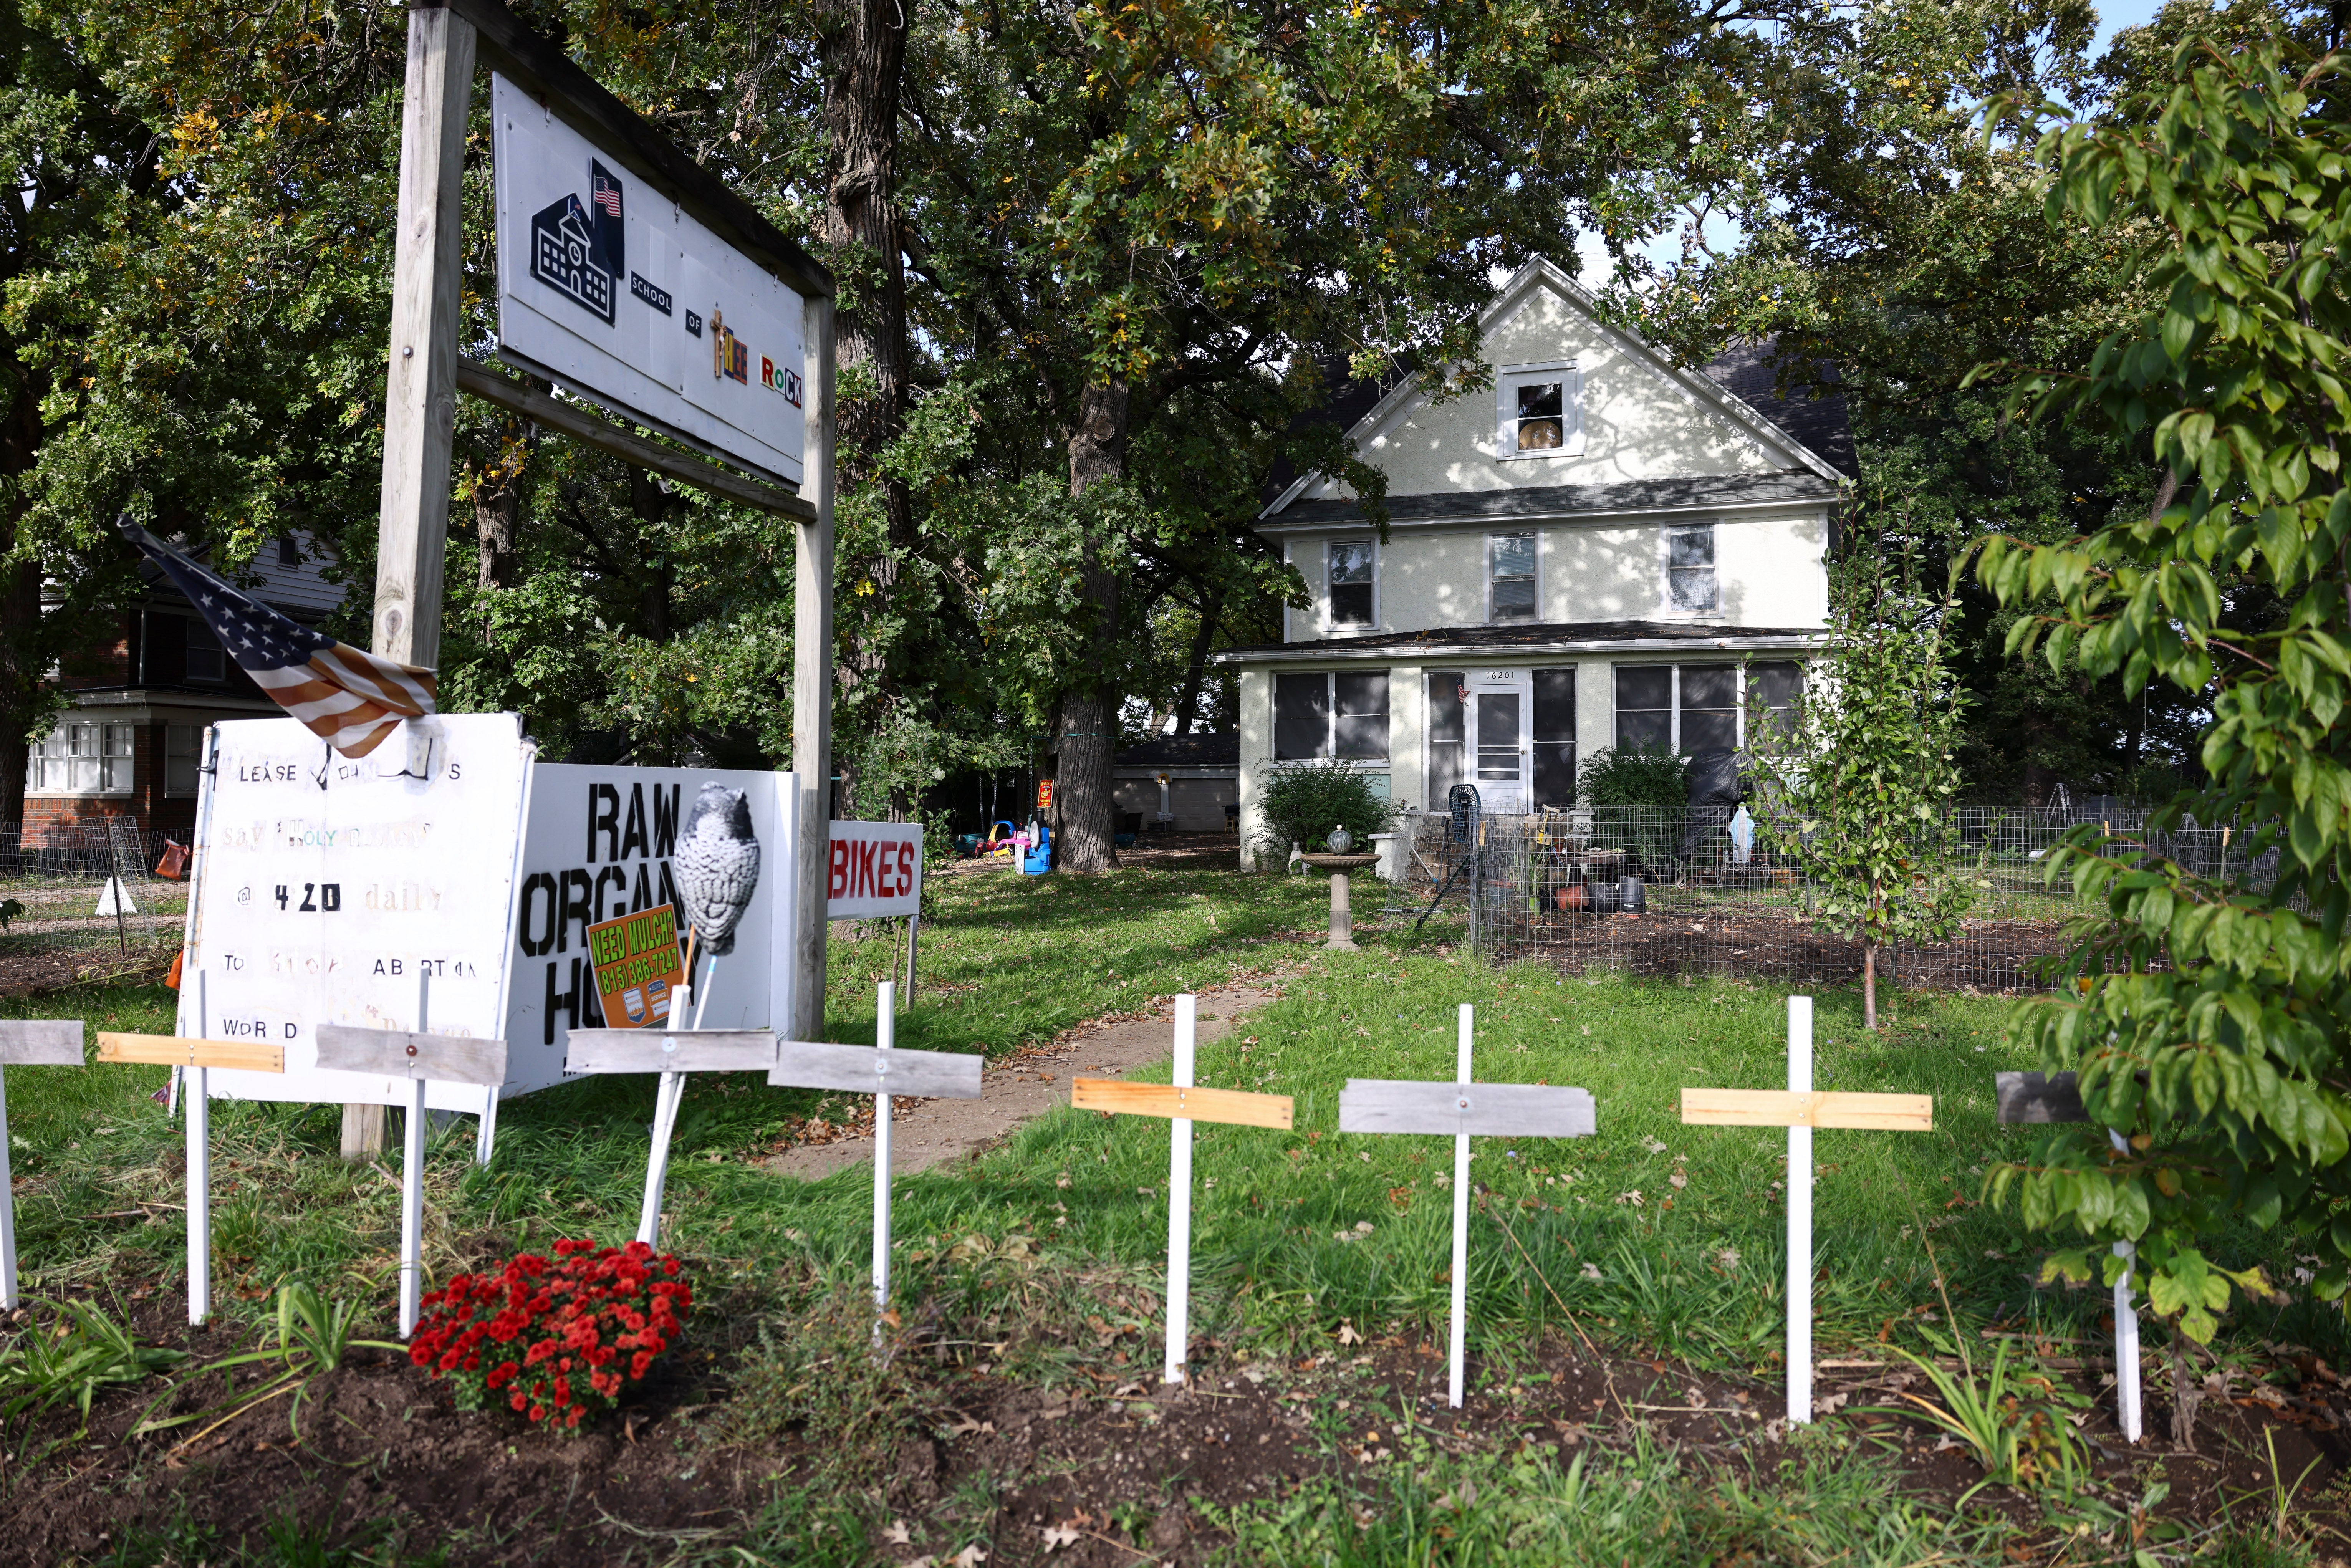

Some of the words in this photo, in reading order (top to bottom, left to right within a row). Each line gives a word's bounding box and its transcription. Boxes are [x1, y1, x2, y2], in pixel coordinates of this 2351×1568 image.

[632, 277, 671, 310] SCHOOL
[689, 315, 700, 330] OF
[587, 782, 680, 863] RAW
[828, 839, 915, 900] BIKES
[520, 861, 686, 957] ORGAN
[224, 954, 244, 971] TO
[591, 924, 626, 967] NEED
[627, 910, 674, 956] MULCH?
[598, 963, 629, 997] (815)
[627, 947, 679, 985] 386-7247
[651, 992, 667, 1001] SERVICE
